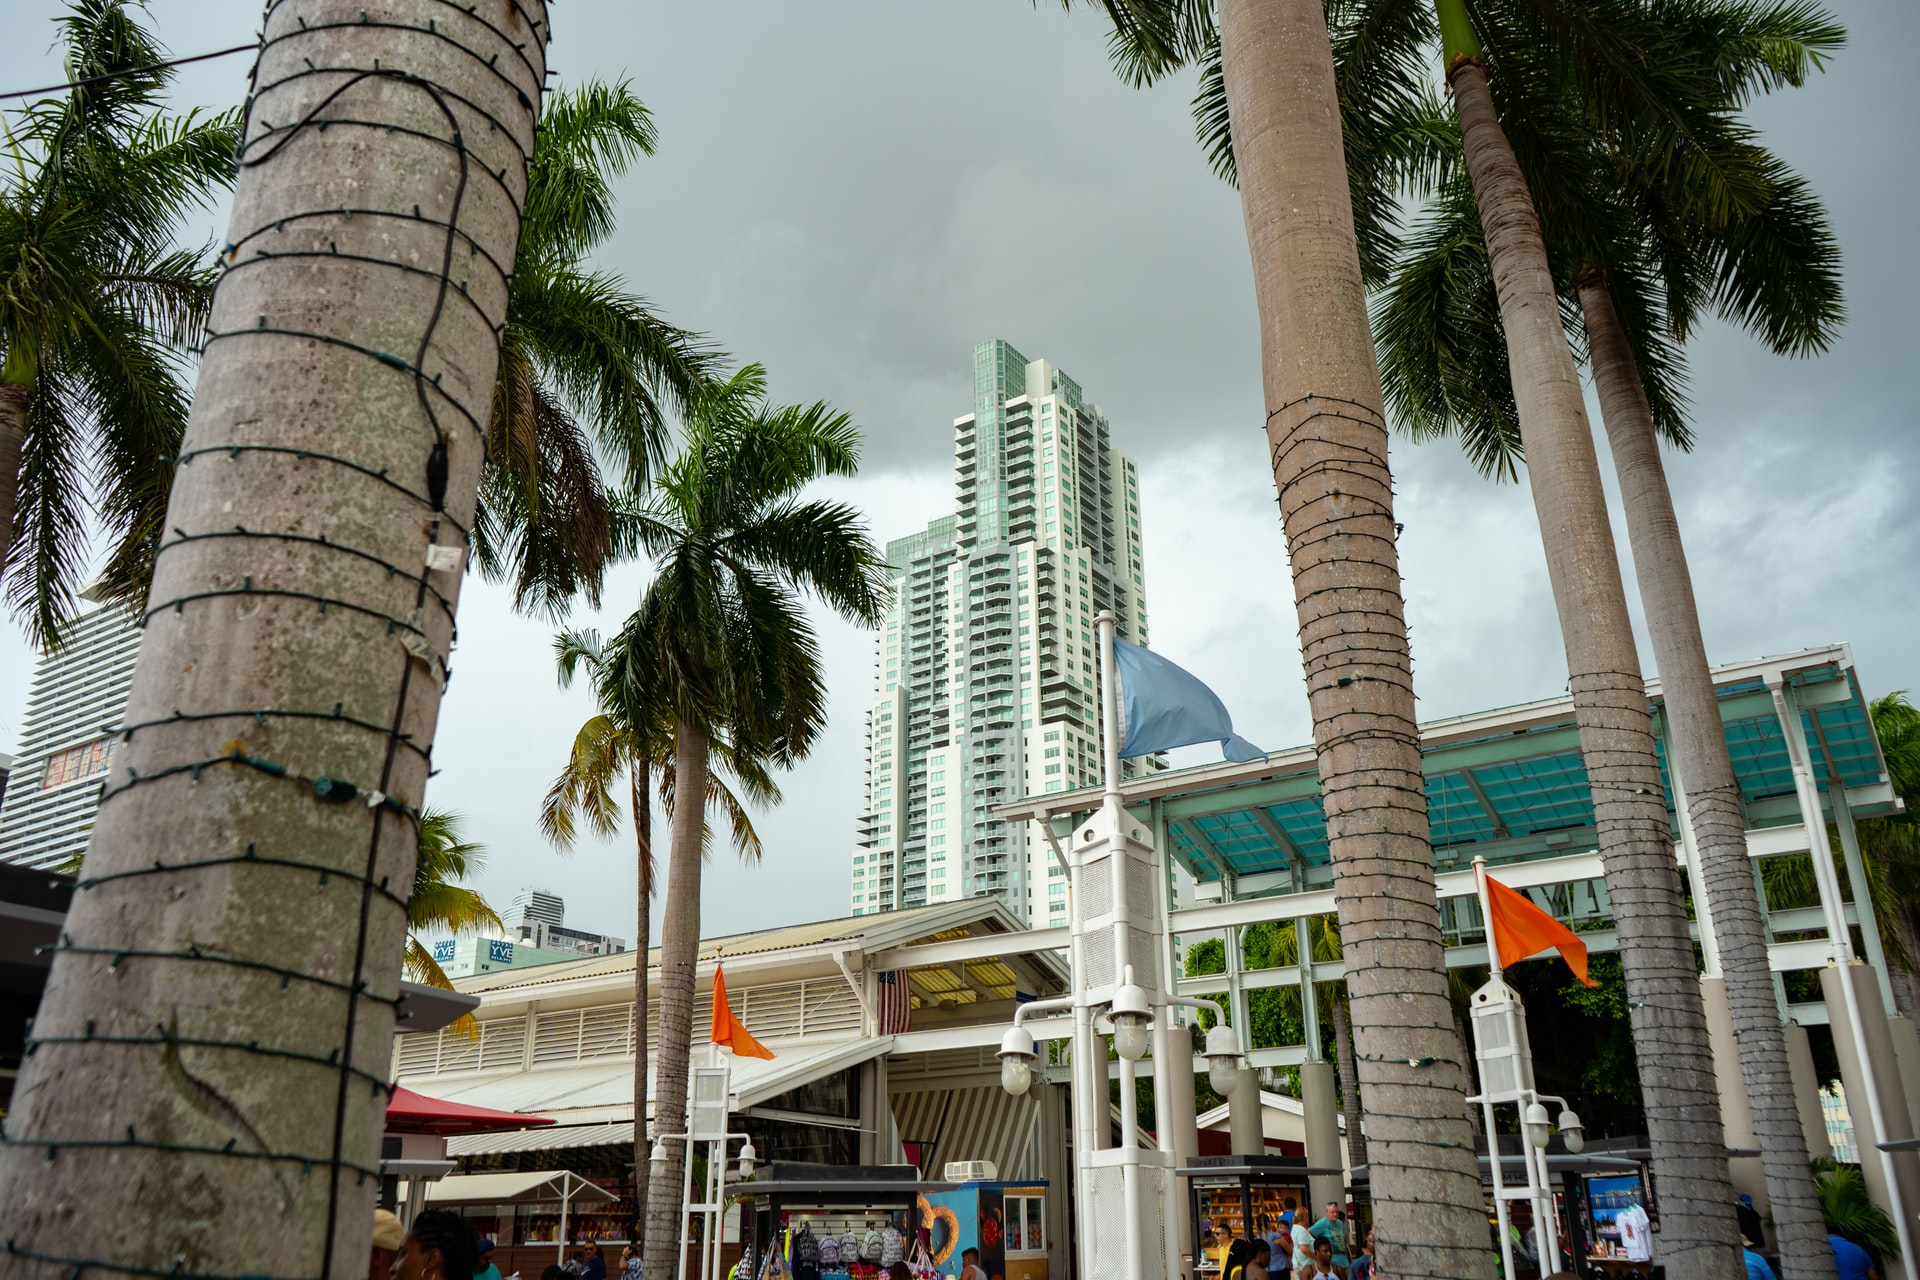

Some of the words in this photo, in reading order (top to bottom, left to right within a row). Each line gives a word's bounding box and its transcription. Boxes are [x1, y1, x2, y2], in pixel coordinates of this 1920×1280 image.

[434, 945, 454, 957] YVE
[491, 945, 513, 958] YVE
[491, 955, 512, 963] MIAMI
